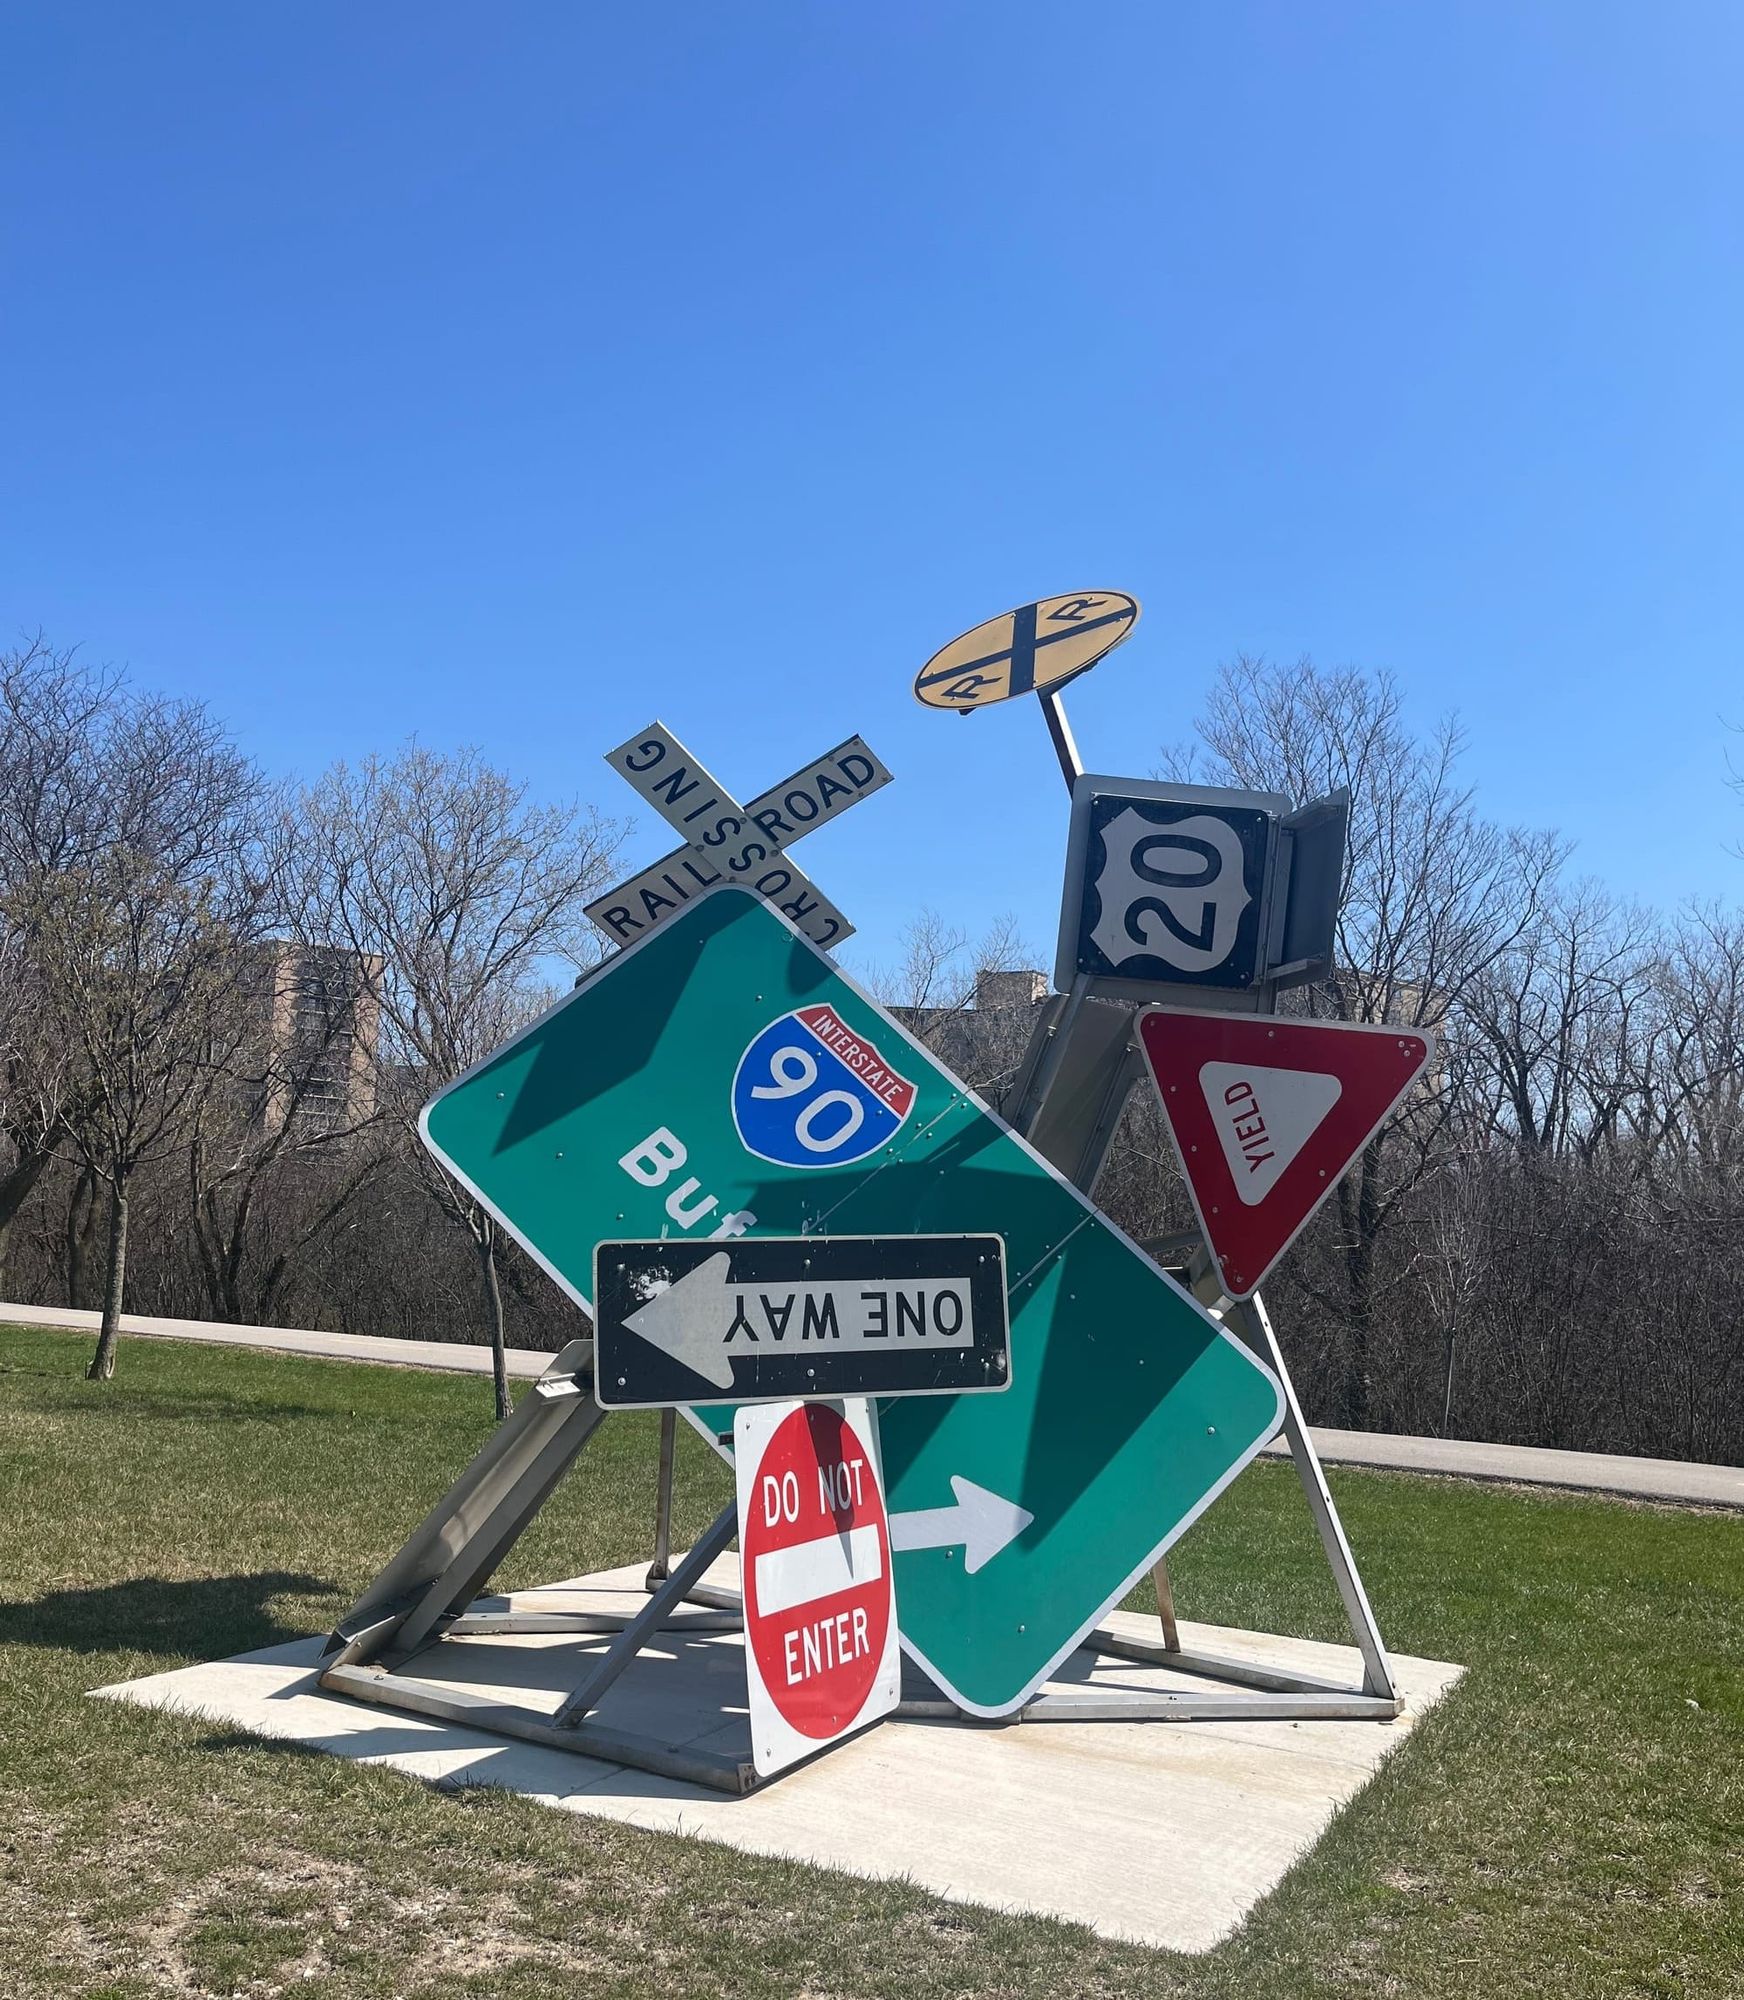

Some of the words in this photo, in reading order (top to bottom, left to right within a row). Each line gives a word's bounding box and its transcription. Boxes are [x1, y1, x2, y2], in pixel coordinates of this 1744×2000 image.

[940, 674, 1003, 700] R
[1046, 597, 1109, 621] R
[601, 861, 722, 938] RAIL
[752, 754, 875, 842] ROAD
[625, 739, 840, 945] CROSSING
[1123, 833, 1223, 953] 20
[750, 1046, 865, 1153] 90
[811, 1013, 904, 1103] INTERSTATE
[1224, 1080, 1276, 1174] YIELD
[618, 1126, 758, 1239] Buf
[722, 1292, 840, 1344] WAY
[860, 1289, 964, 1339] ONE
[762, 1468, 799, 1529] DO
[817, 1458, 864, 1515] NOT
[783, 1606, 871, 1687] ENTER
